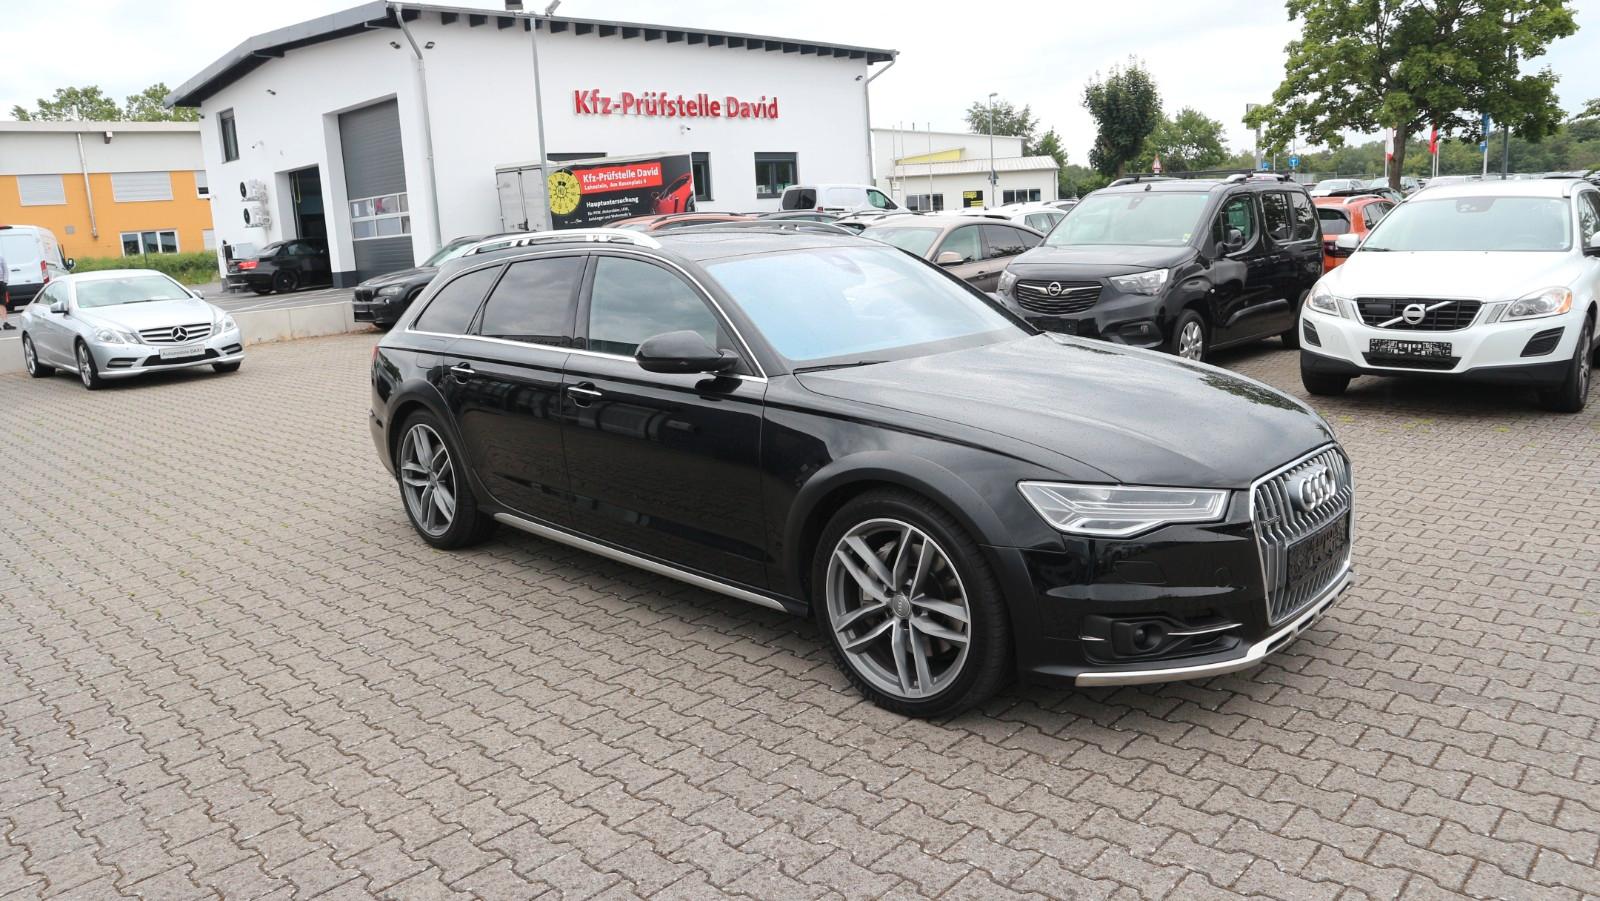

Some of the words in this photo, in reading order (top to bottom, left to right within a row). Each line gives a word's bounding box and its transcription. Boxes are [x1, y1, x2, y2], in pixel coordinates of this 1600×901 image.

[574, 88, 721, 118] Kfz-Prüfstelle
[726, 95, 779, 119] David
[583, 169, 636, 183] Kfz-Prüfstelle
[637, 167, 659, 177] David
[586, 196, 639, 208] Hauptuntersuchung
